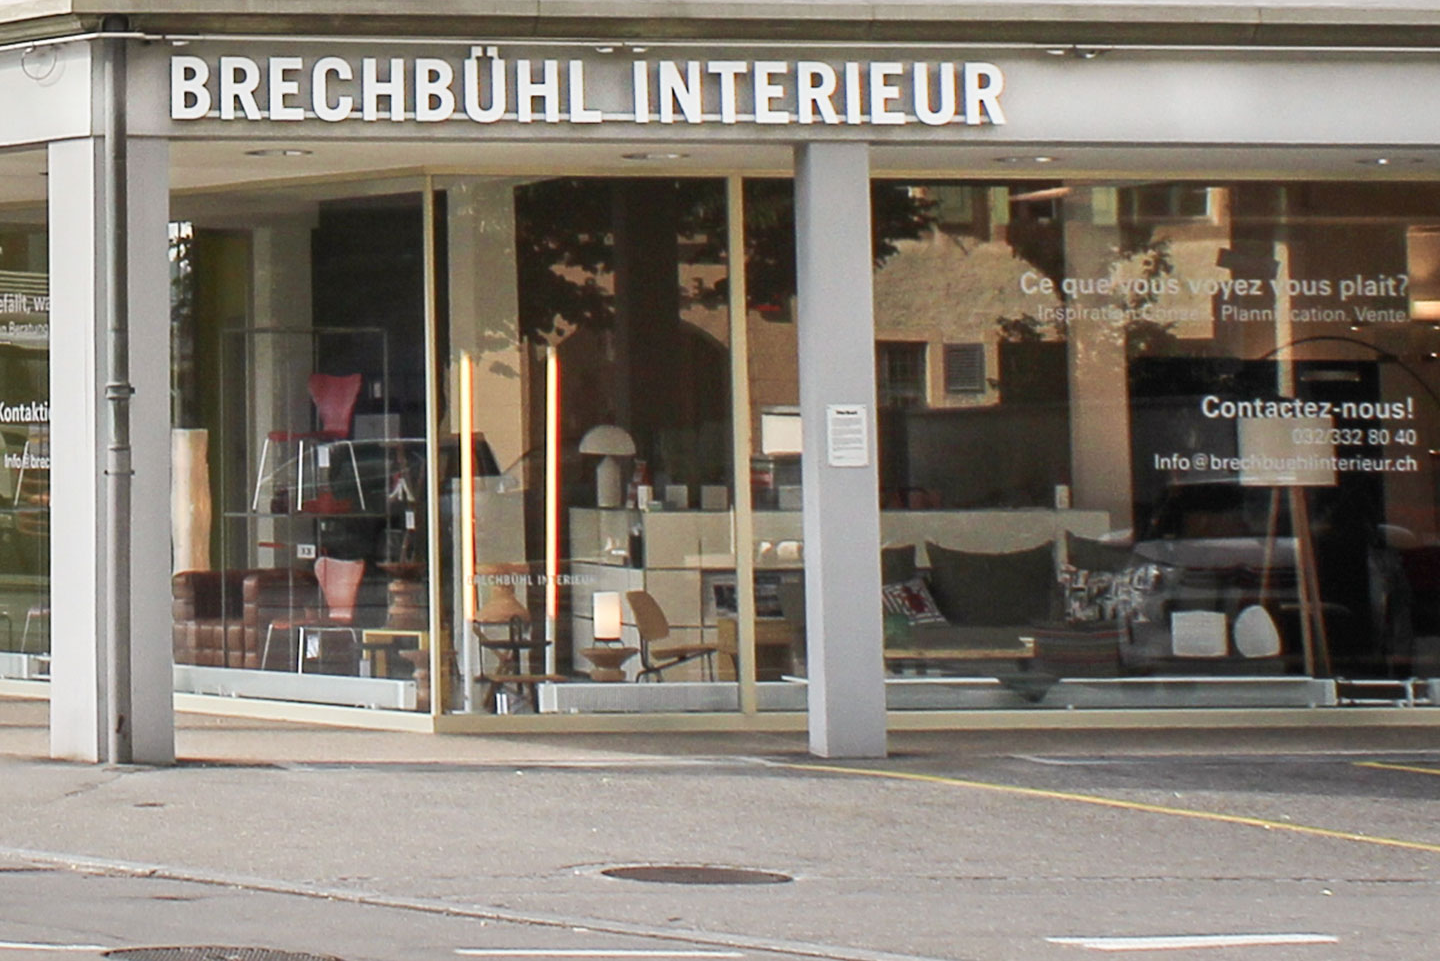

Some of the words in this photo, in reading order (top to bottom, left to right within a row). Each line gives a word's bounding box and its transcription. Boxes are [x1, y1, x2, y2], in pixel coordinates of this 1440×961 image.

[171, 46, 603, 123] BRECHBÜHL
[633, 59, 1007, 126] INTERIEUR
[1020, 271, 1053, 295] Ce
[1062, 277, 1111, 299] que
[1118, 277, 1179, 295] vous
[1189, 277, 1262, 300] voyez
[1340, 274, 1409, 301] plait?
[1201, 395, 1415, 419] Contactez-nous!
[1368, 429, 1390, 446] 80
[1394, 430, 1418, 446] 40
